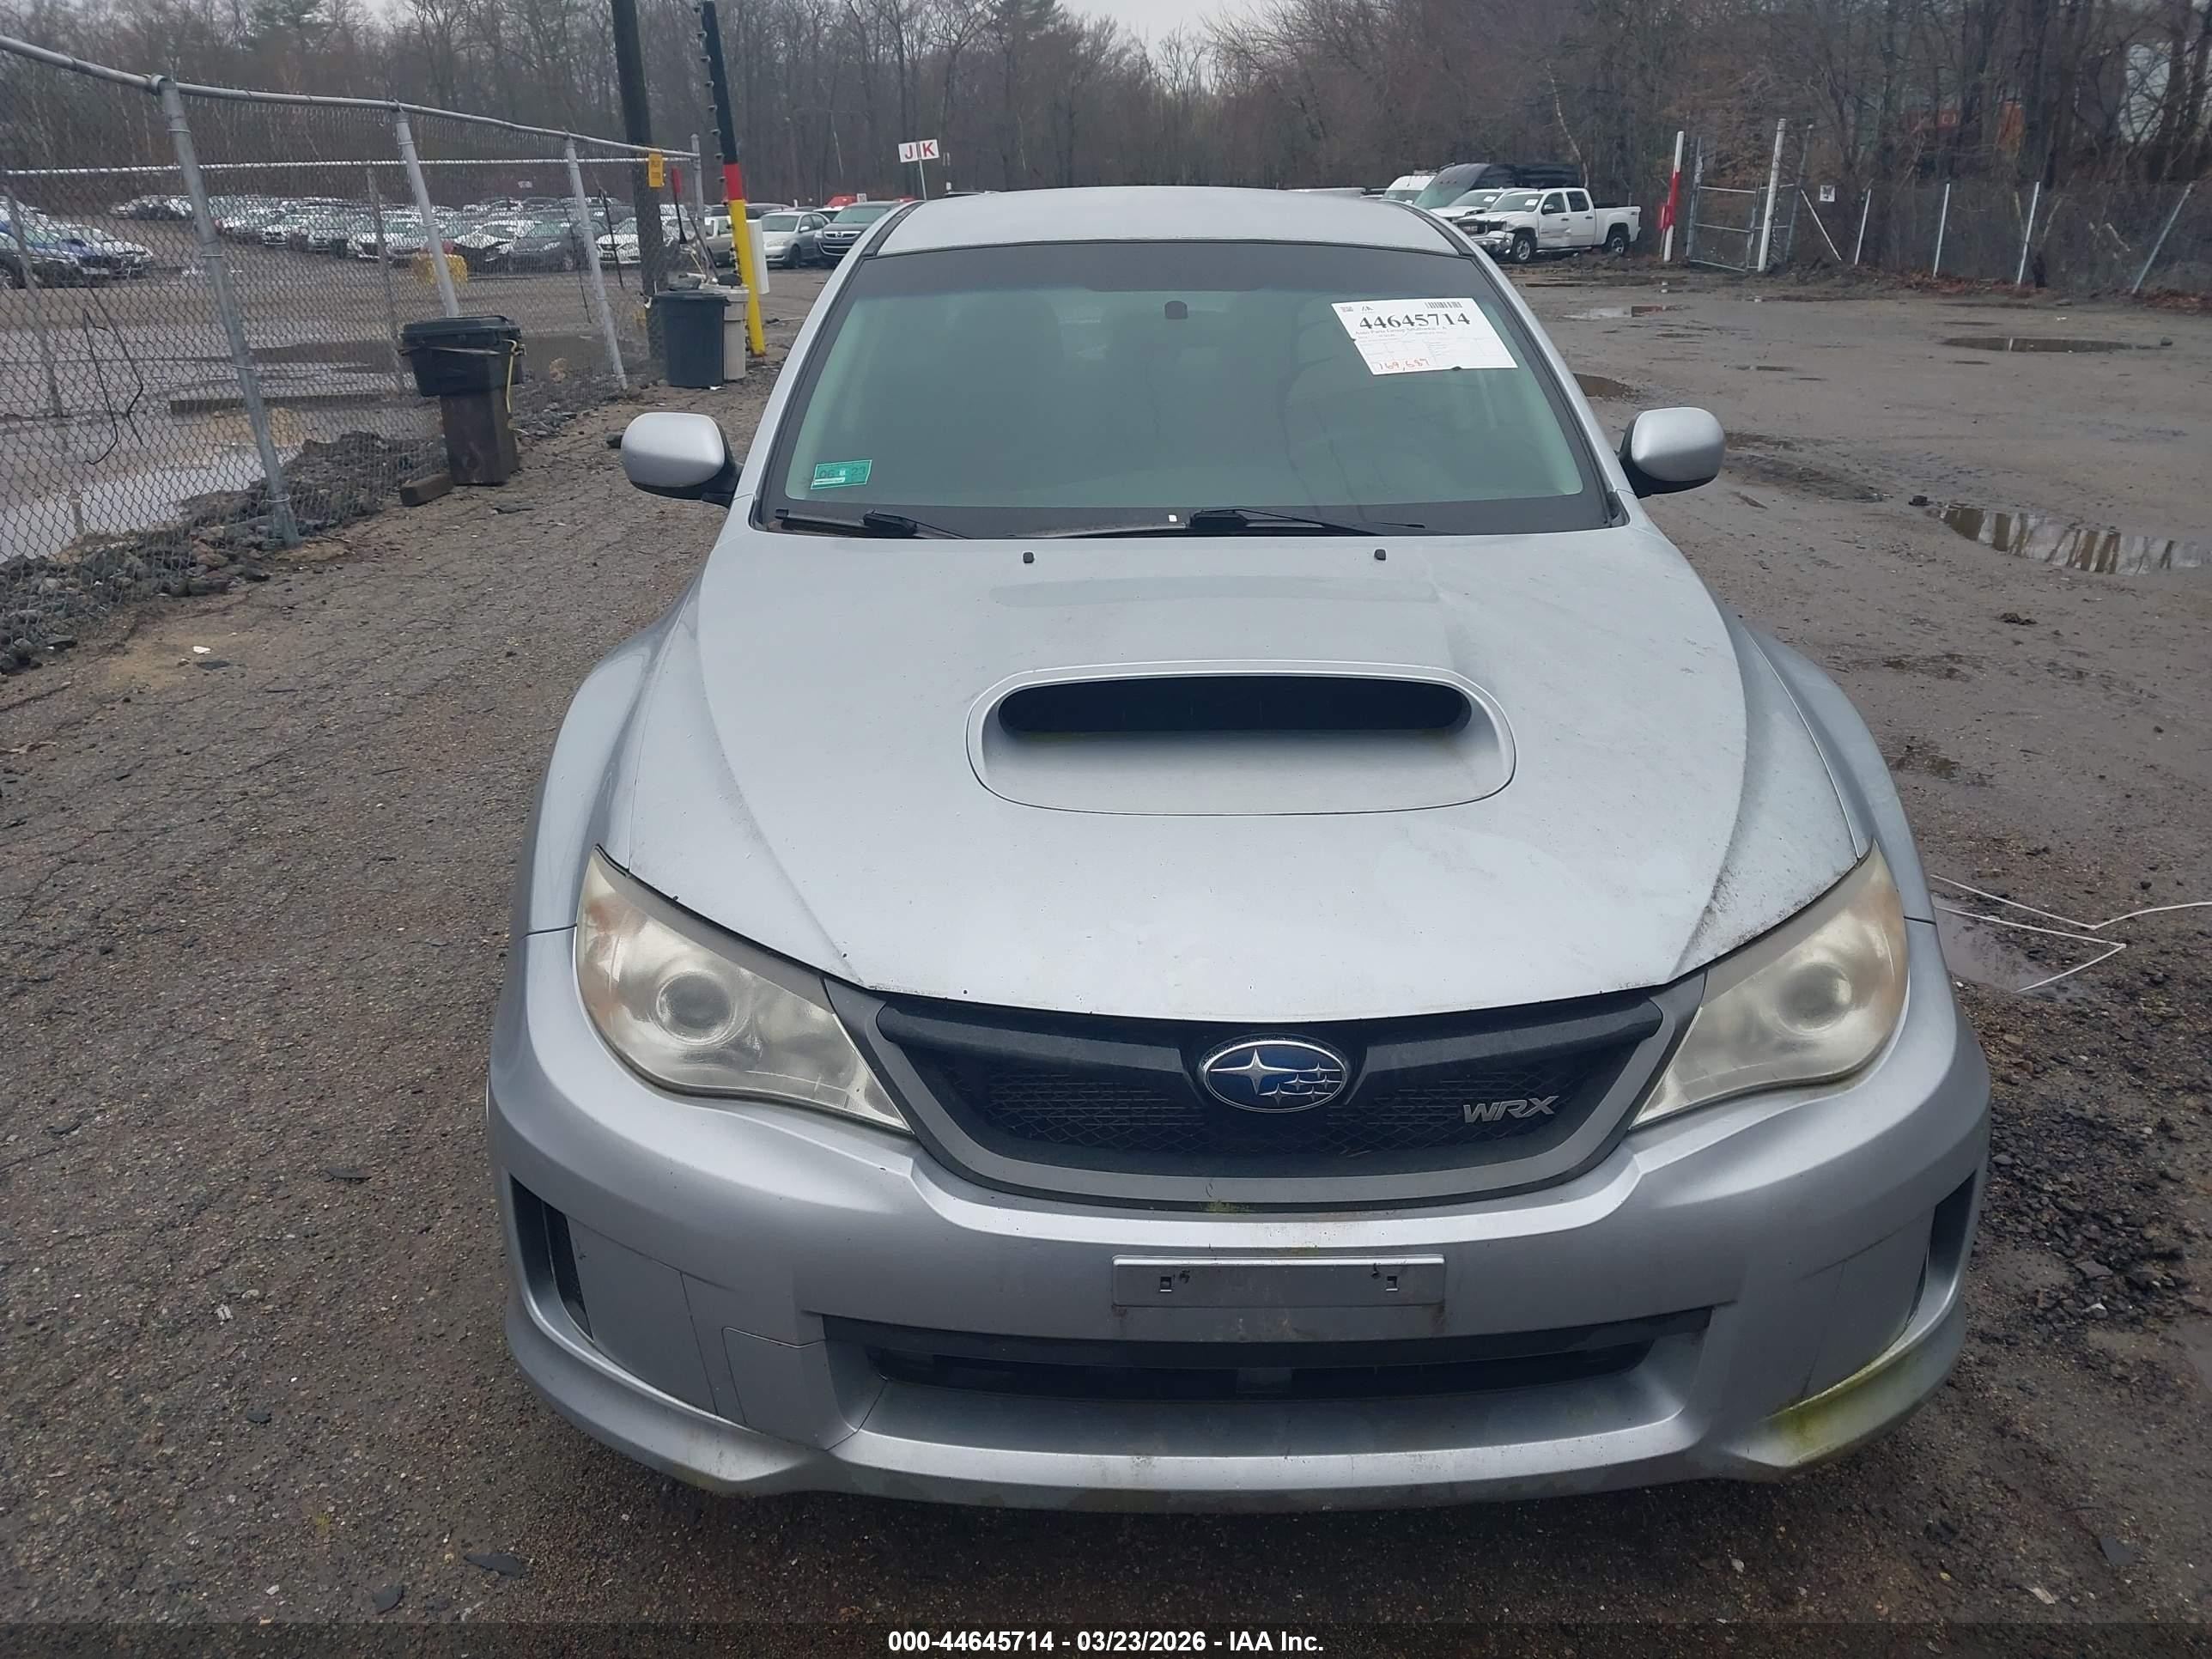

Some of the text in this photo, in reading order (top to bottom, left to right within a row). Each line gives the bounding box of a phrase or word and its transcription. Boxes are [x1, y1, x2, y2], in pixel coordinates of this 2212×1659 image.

[904, 142, 935, 160] J K
[1358, 313, 1471, 330] 44645714
[1462, 1096, 1559, 1124] WRX
